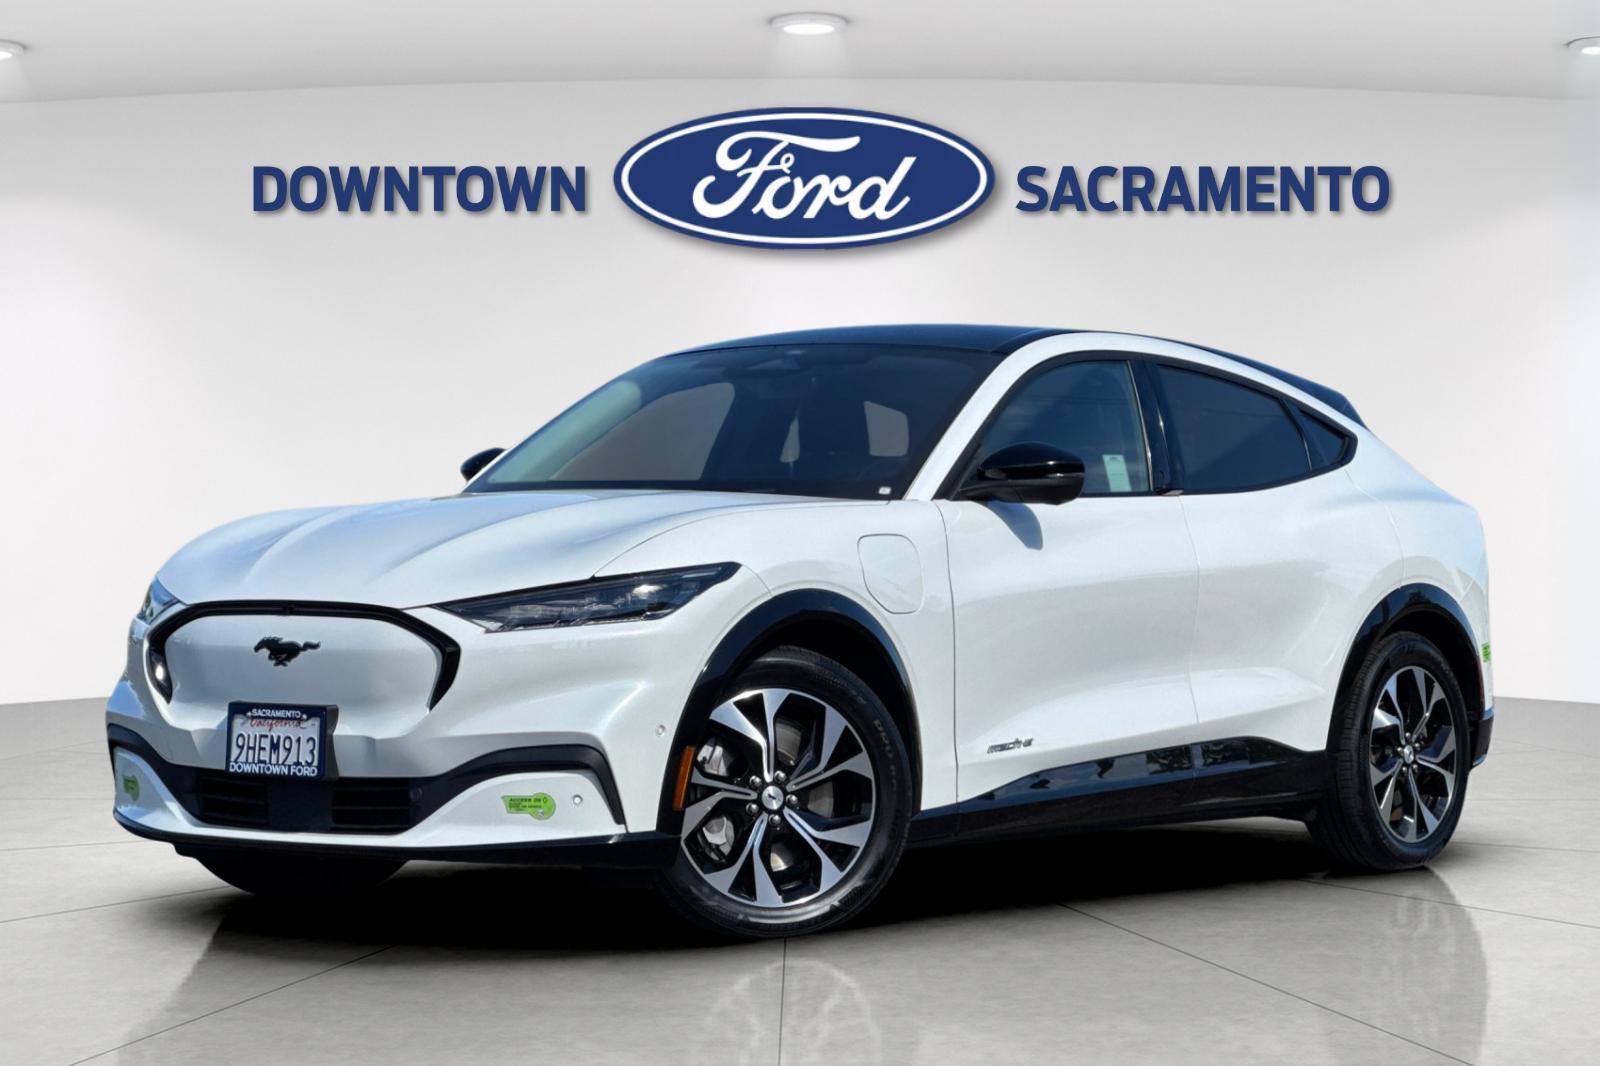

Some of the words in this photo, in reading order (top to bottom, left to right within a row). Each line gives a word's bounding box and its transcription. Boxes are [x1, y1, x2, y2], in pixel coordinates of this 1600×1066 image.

[252, 166, 586, 213] DOWNTOWN
[692, 131, 917, 220] Ford
[1015, 165, 1391, 213] SACRAMENTO
[251, 708, 302, 719] SACRAMENTO
[233, 732, 316, 766] 9HEM913
[228, 762, 288, 776] DOWNTOWN
[289, 764, 318, 777] FORD
